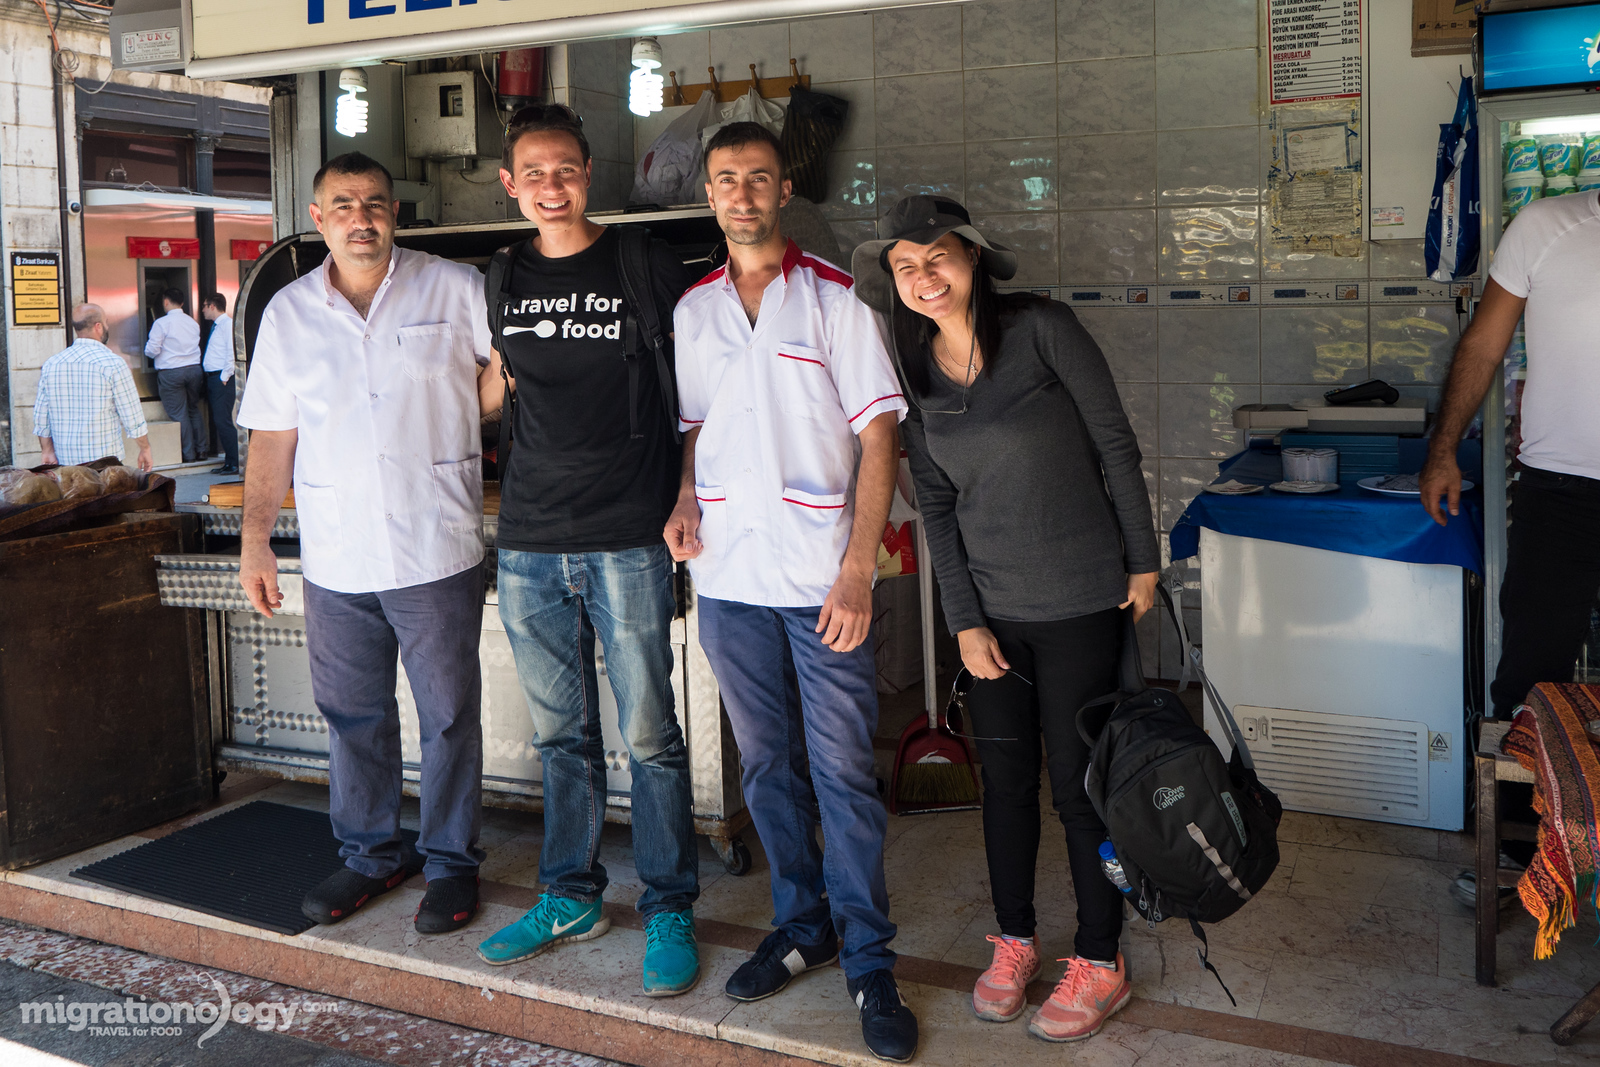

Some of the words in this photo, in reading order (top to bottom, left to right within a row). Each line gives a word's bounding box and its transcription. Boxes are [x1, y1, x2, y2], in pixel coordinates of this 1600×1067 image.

[1272, 18, 1290, 26] ÇEYREK
[139, 32, 172, 42] TUNÇ
[1273, 33, 1296, 42] PORSİYON
[1273, 43, 1296, 51] PORSİYON
[1273, 50, 1311, 60] MEŞRUBATLAR
[585, 293, 622, 312] for
[562, 319, 621, 339] food
[1162, 785, 1184, 799] Lowe
[1161, 792, 1185, 809] alpine
[1232, 810, 1246, 842] VECTOR
